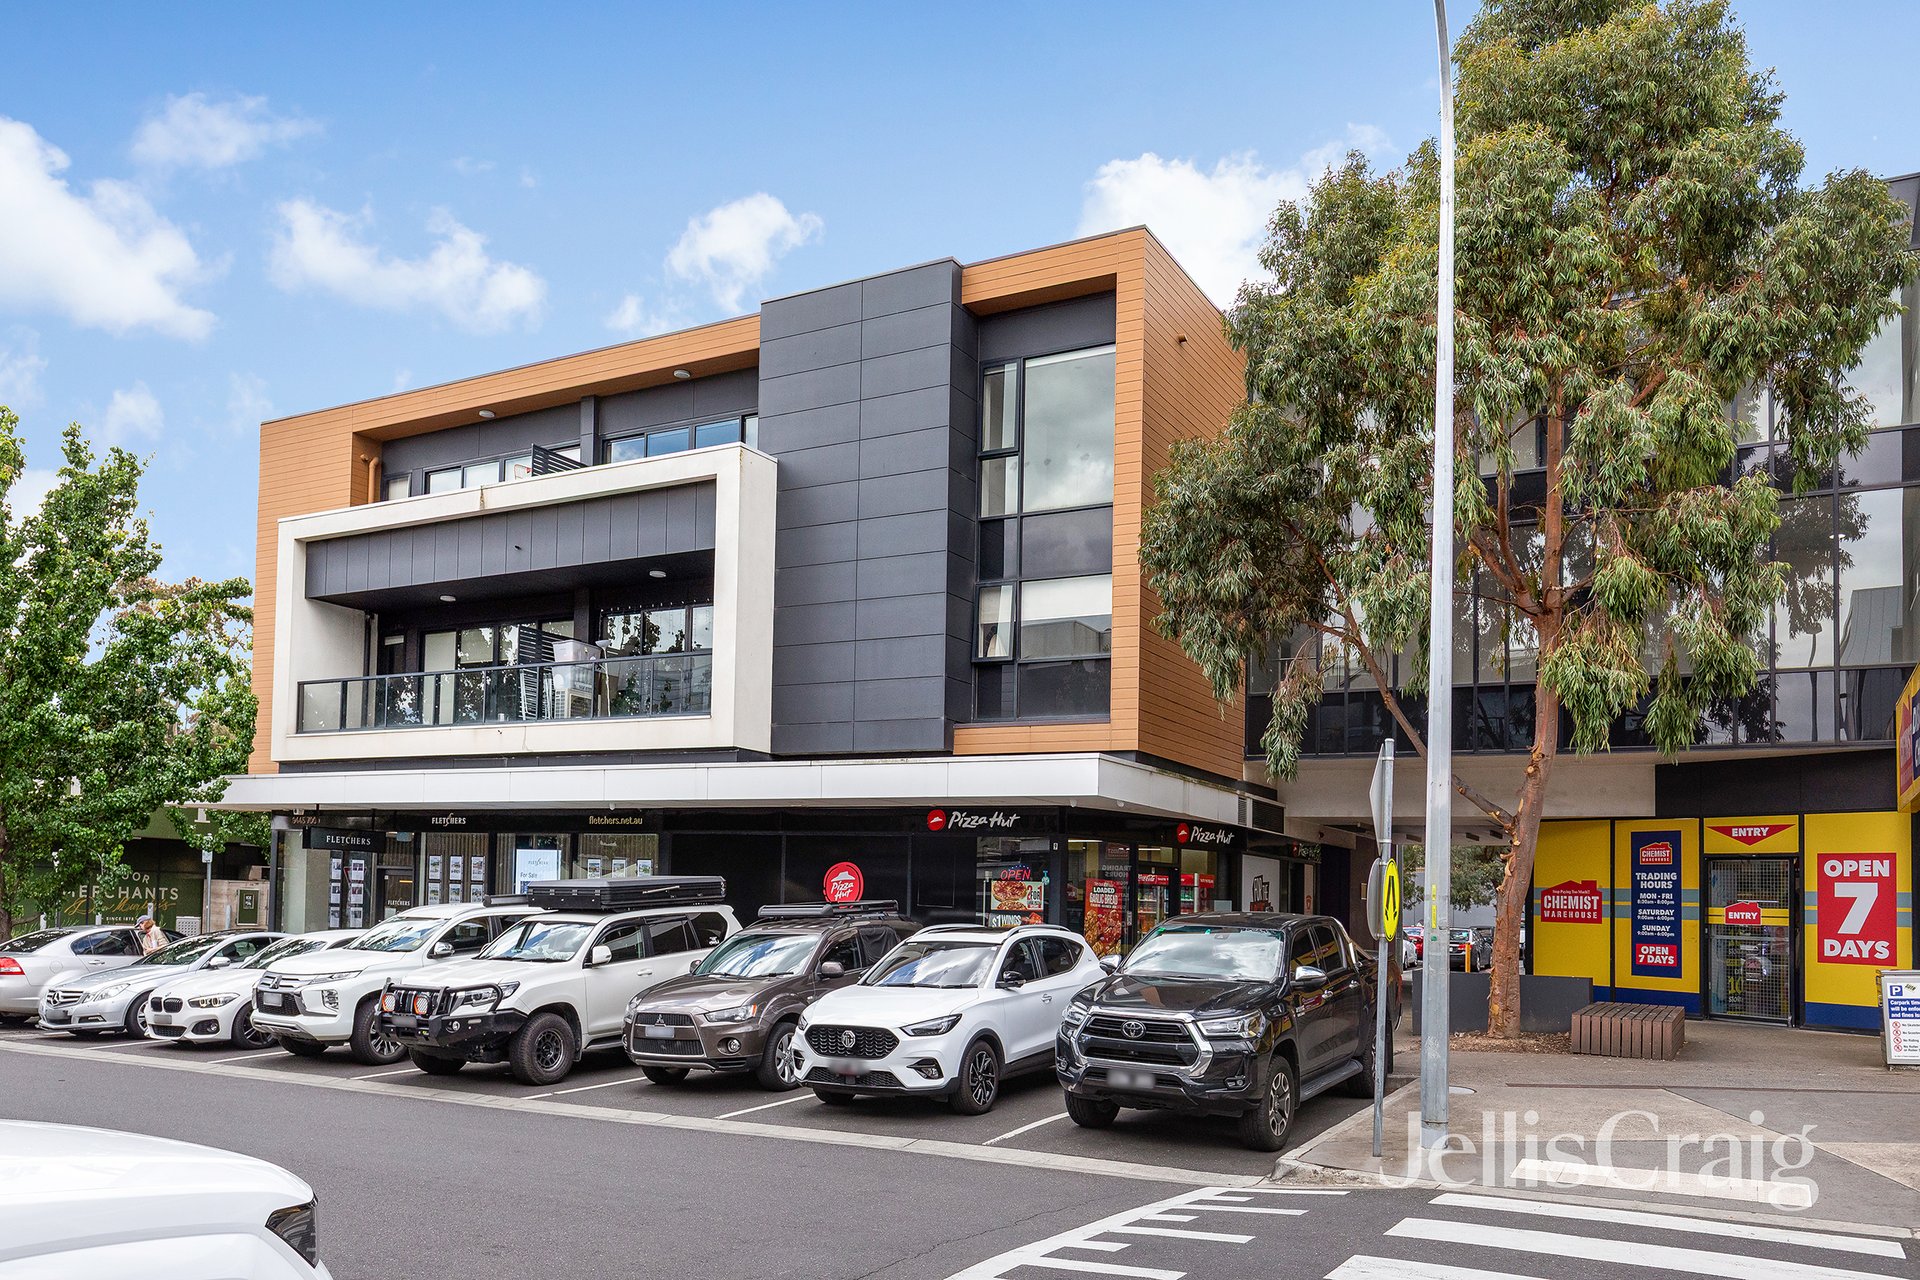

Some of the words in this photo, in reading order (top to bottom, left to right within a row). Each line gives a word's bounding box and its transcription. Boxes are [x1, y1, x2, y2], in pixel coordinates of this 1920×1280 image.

[431, 813, 467, 826] FLETCHERS
[588, 815, 643, 825] fletchers.net.au
[948, 811, 988, 829] Pizza
[989, 811, 1021, 828] Hut
[1190, 826, 1216, 843] Pizza
[1215, 829, 1235, 844] Hut
[1731, 827, 1770, 837] ENTRY
[326, 835, 371, 845] FLETCHERS
[1642, 850, 1670, 858] CHEMIST
[1823, 859, 1890, 878] OPEN
[1000, 869, 1032, 881] OPEN
[1635, 872, 1678, 880] TRADING
[831, 880, 854, 894] Pizza
[1093, 886, 1115, 894] LOADED
[1640, 881, 1673, 889] HOURS
[834, 889, 853, 901] Hut
[1640, 892, 1657, 900] MON
[1543, 895, 1600, 910] CHEMIST
[1637, 908, 1675, 916] SATURDAY
[1834, 882, 1879, 935] 7
[1543, 910, 1598, 919] WAREHOUSE
[1727, 911, 1758, 920] ENTRY
[1001, 914, 1022, 927] WINGS
[1641, 924, 1671, 932] SUNDAY
[1640, 945, 1669, 955] OPEN
[1823, 939, 1890, 959] DAYS
[1638, 954, 1645, 963] 7
[1646, 955, 1675, 965] DAYS
[1892, 986, 1901, 996] P
